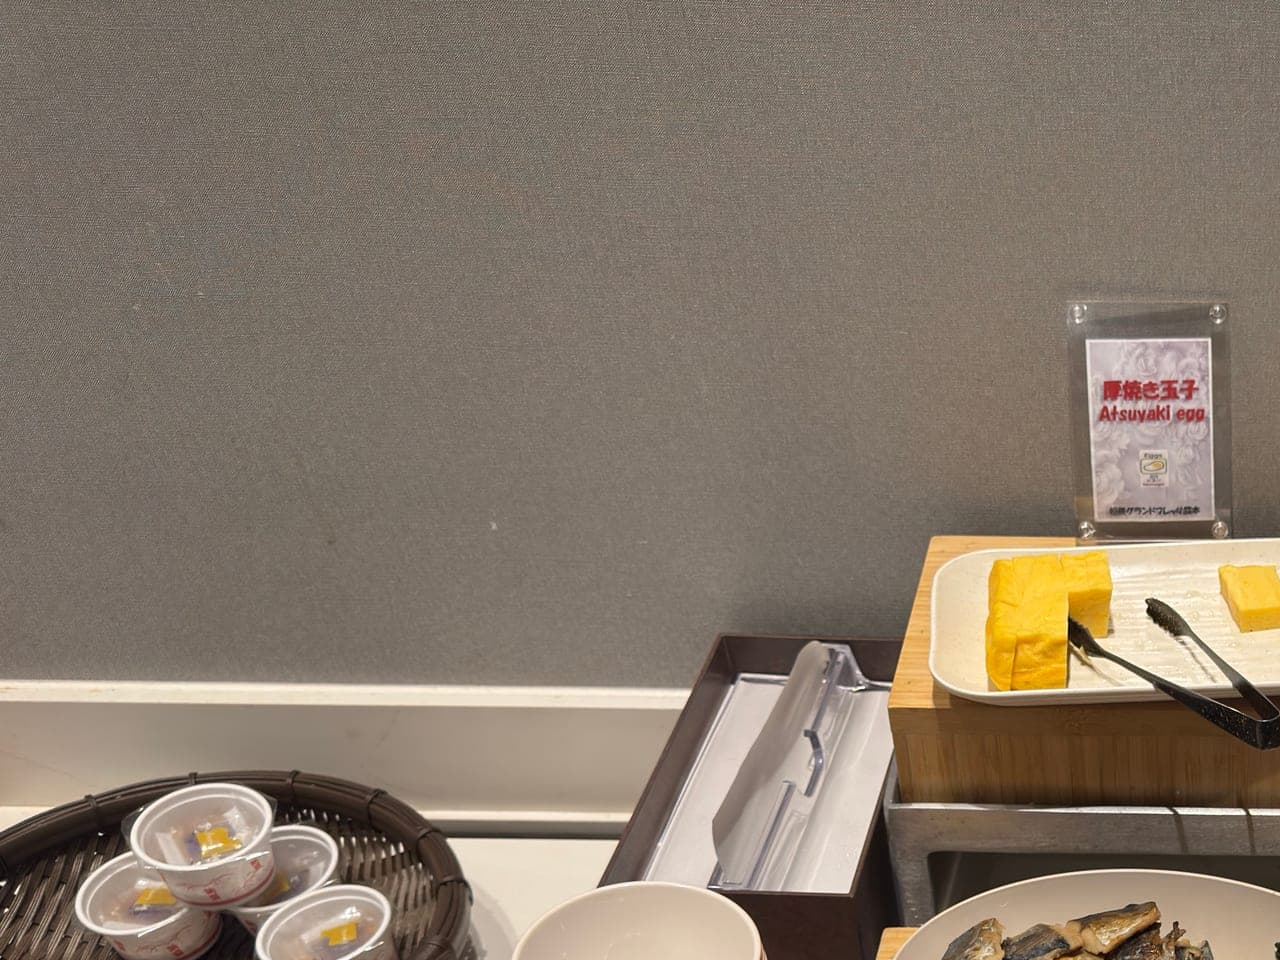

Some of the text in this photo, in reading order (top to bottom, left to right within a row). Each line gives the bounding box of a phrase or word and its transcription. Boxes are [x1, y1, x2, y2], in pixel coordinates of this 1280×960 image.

[1103, 380, 1199, 401] 厚焼き玉子
[1099, 405, 1205, 423] Atsuyaki egg
